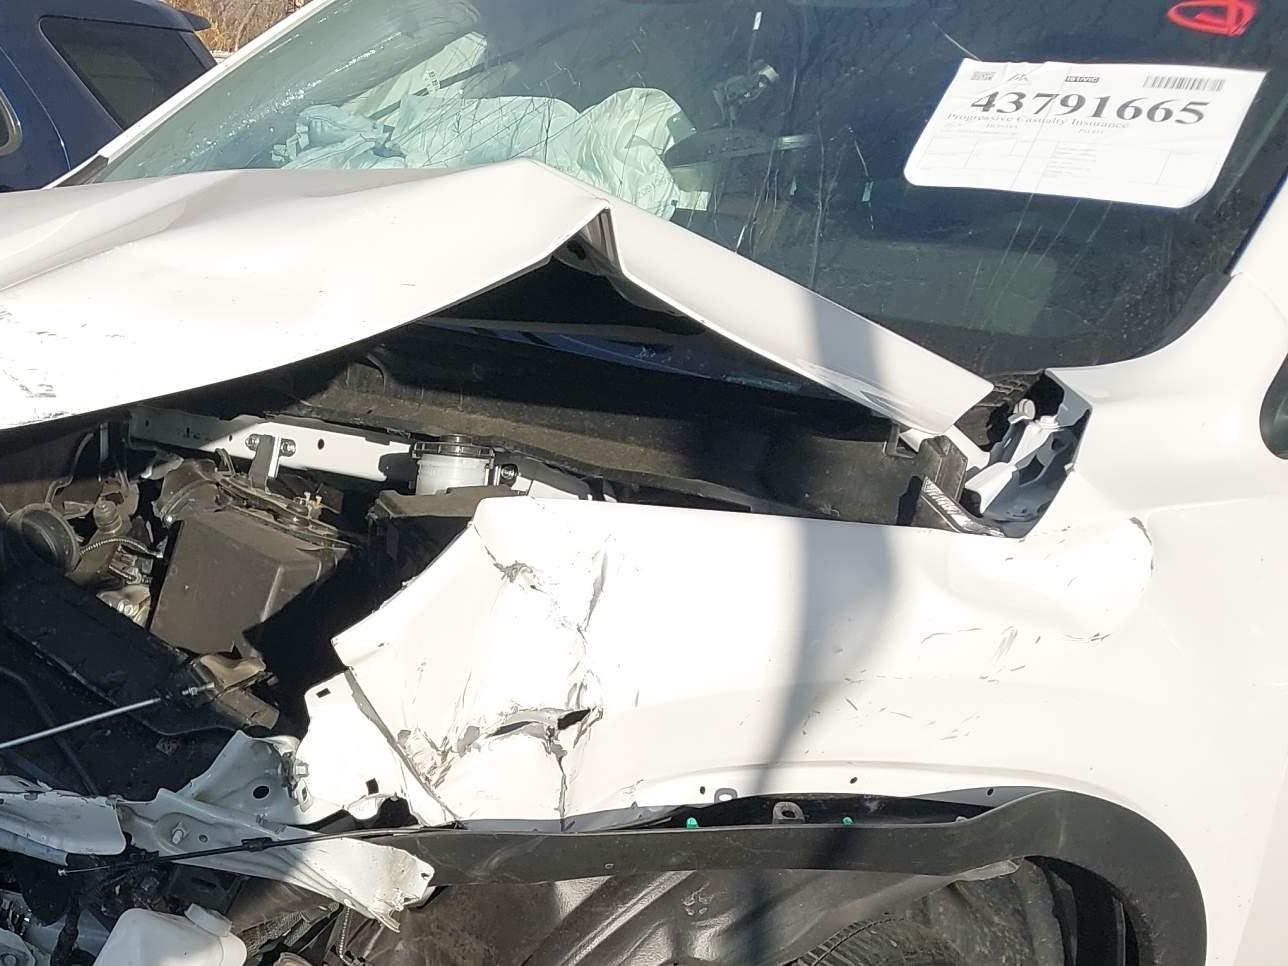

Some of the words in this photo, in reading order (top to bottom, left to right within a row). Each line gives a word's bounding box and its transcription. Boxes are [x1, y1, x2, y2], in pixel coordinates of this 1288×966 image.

[945, 112, 1015, 123] Progressive
[1016, 115, 1067, 126] Casualty
[1071, 118, 1129, 129] Insurance
[971, 90, 1210, 125] 43791665
